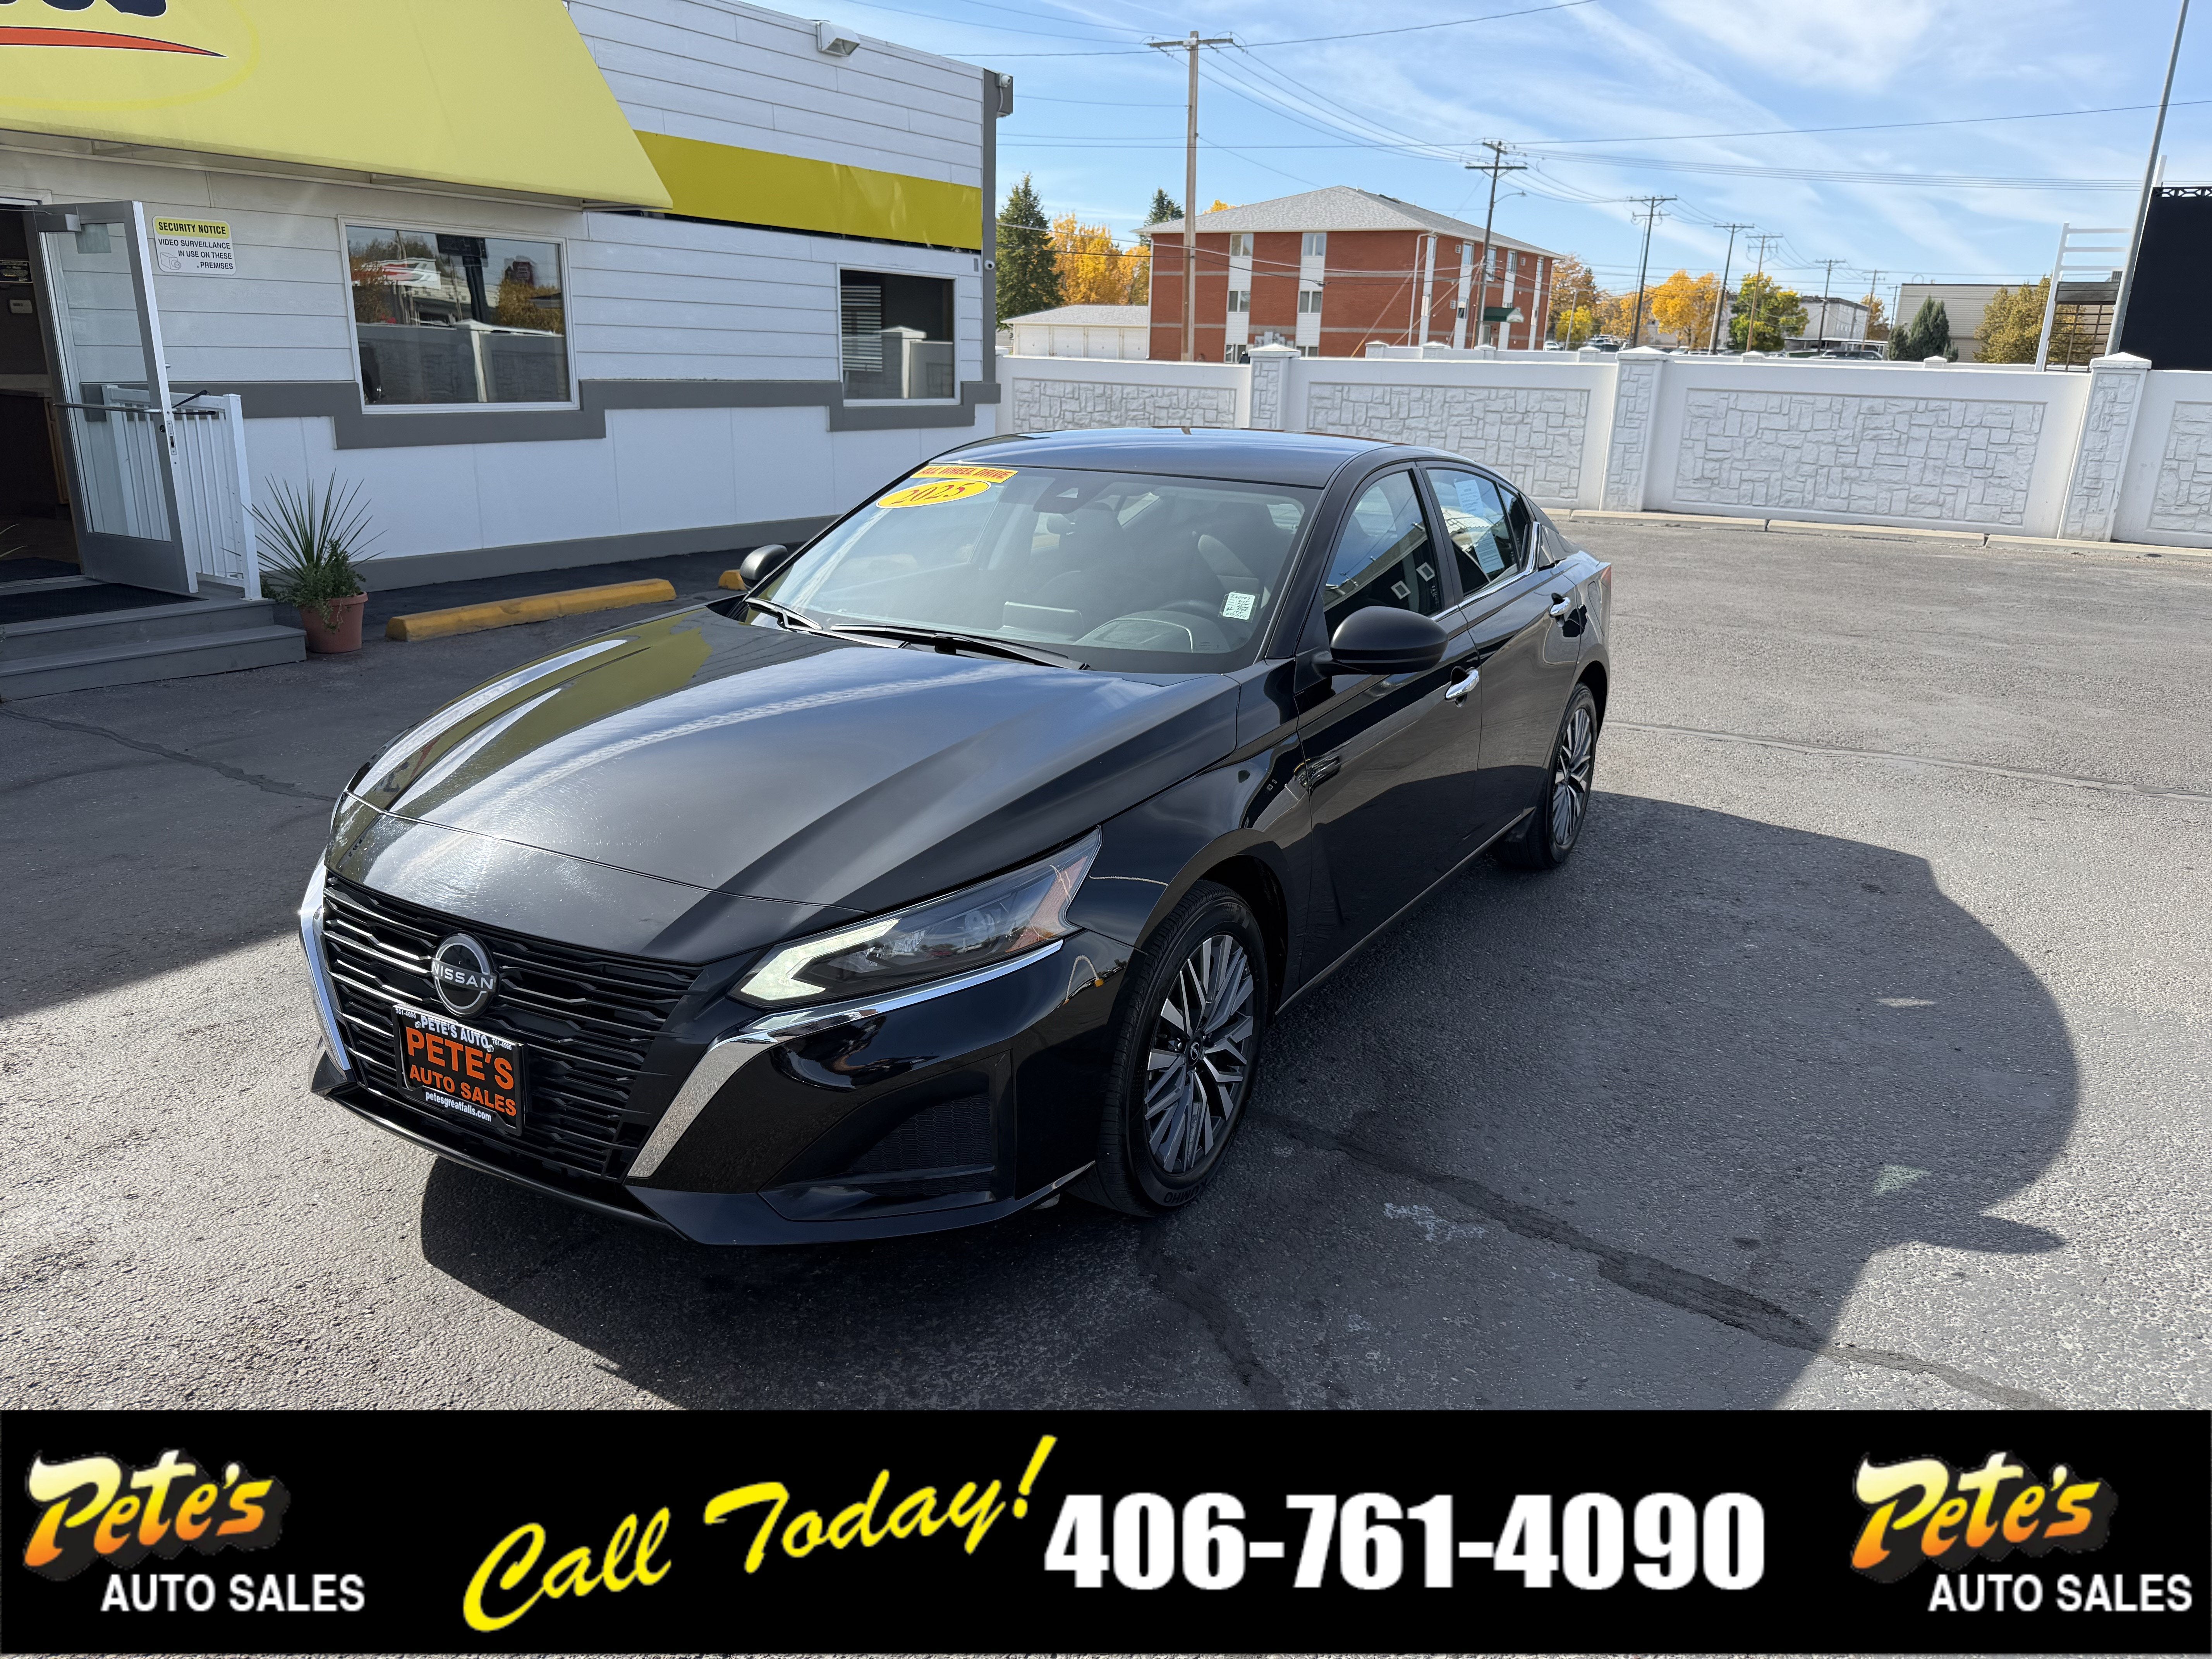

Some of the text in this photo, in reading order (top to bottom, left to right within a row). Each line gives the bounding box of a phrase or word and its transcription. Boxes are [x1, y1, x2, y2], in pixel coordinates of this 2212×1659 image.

[158, 222, 226, 234] SECURITY NOTICE
[180, 240, 230, 249] SURVEILLANCE
[200, 261, 233, 270] PREMISES
[938, 467, 978, 476] WHEEL
[971, 469, 1014, 479] DRIVE
[891, 482, 976, 505] 2025
[432, 961, 493, 989] NISSAN
[421, 1015, 489, 1049] PETE'S AUTO
[405, 1026, 514, 1090] PETE'S
[409, 1065, 517, 1116] AUTO SALES
[425, 1092, 492, 1122] petesgreatfalls.com
